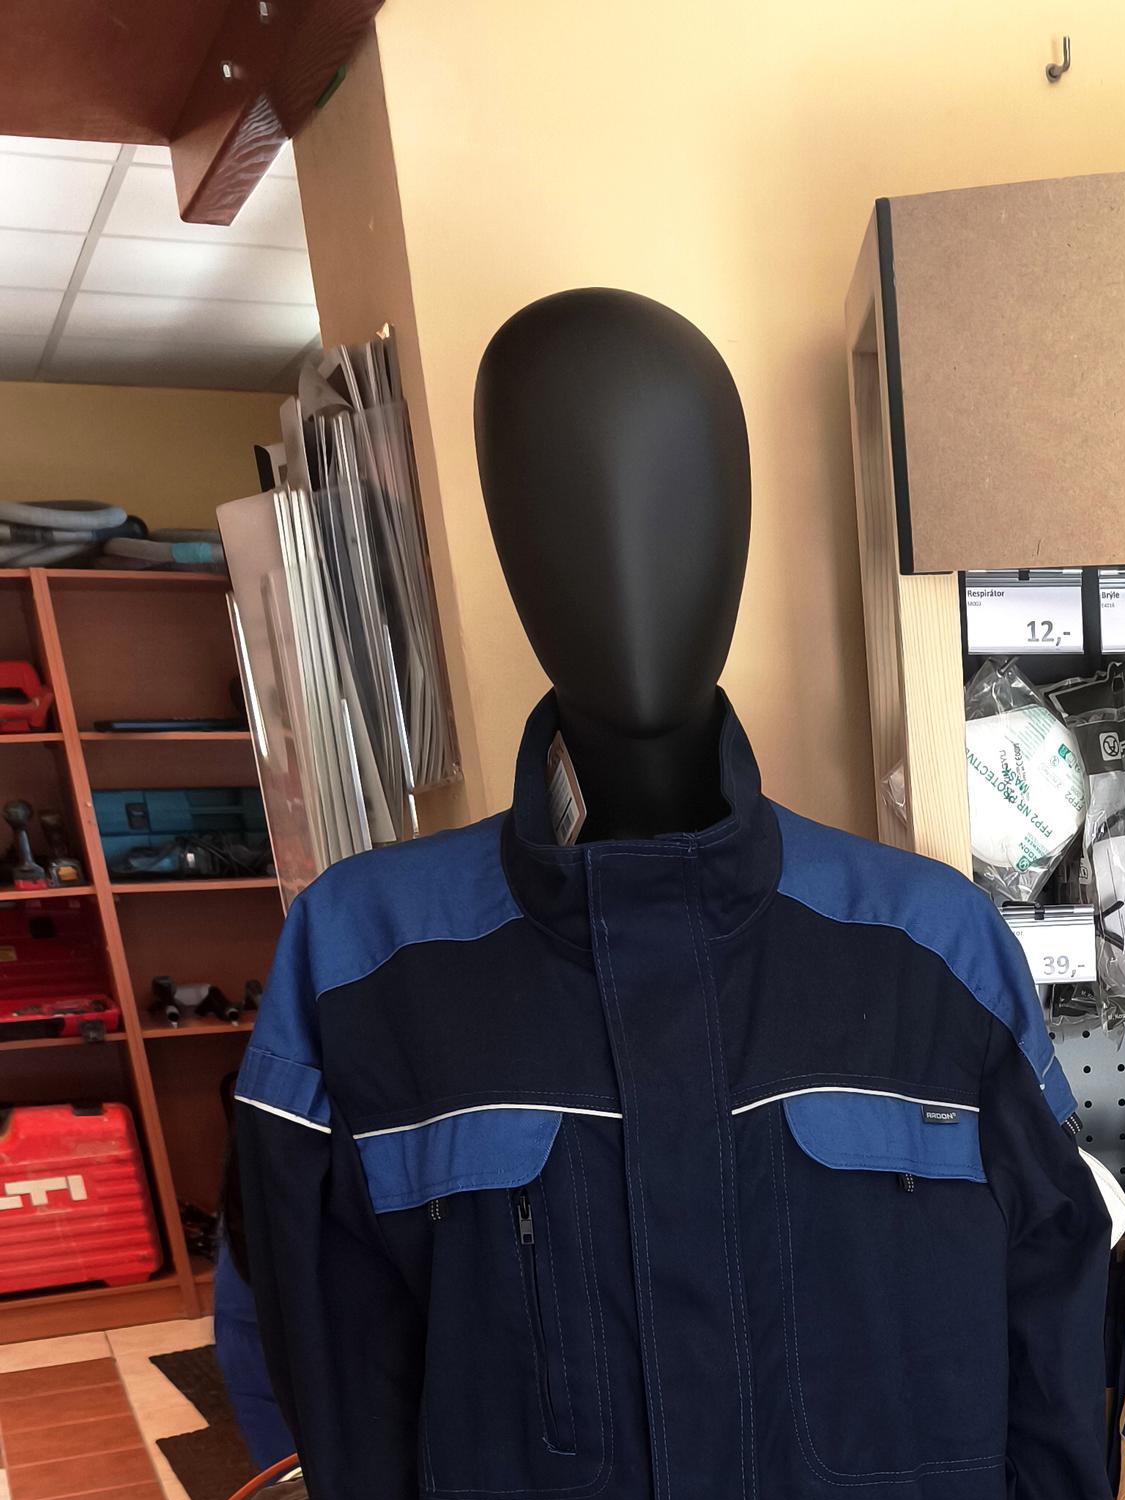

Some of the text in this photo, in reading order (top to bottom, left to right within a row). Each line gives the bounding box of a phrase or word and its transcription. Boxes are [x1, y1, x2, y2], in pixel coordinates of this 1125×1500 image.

[1101, 591, 1120, 600] Brýle
[1027, 620, 1071, 647] 12,-
[1043, 955, 1085, 978] 39,-
